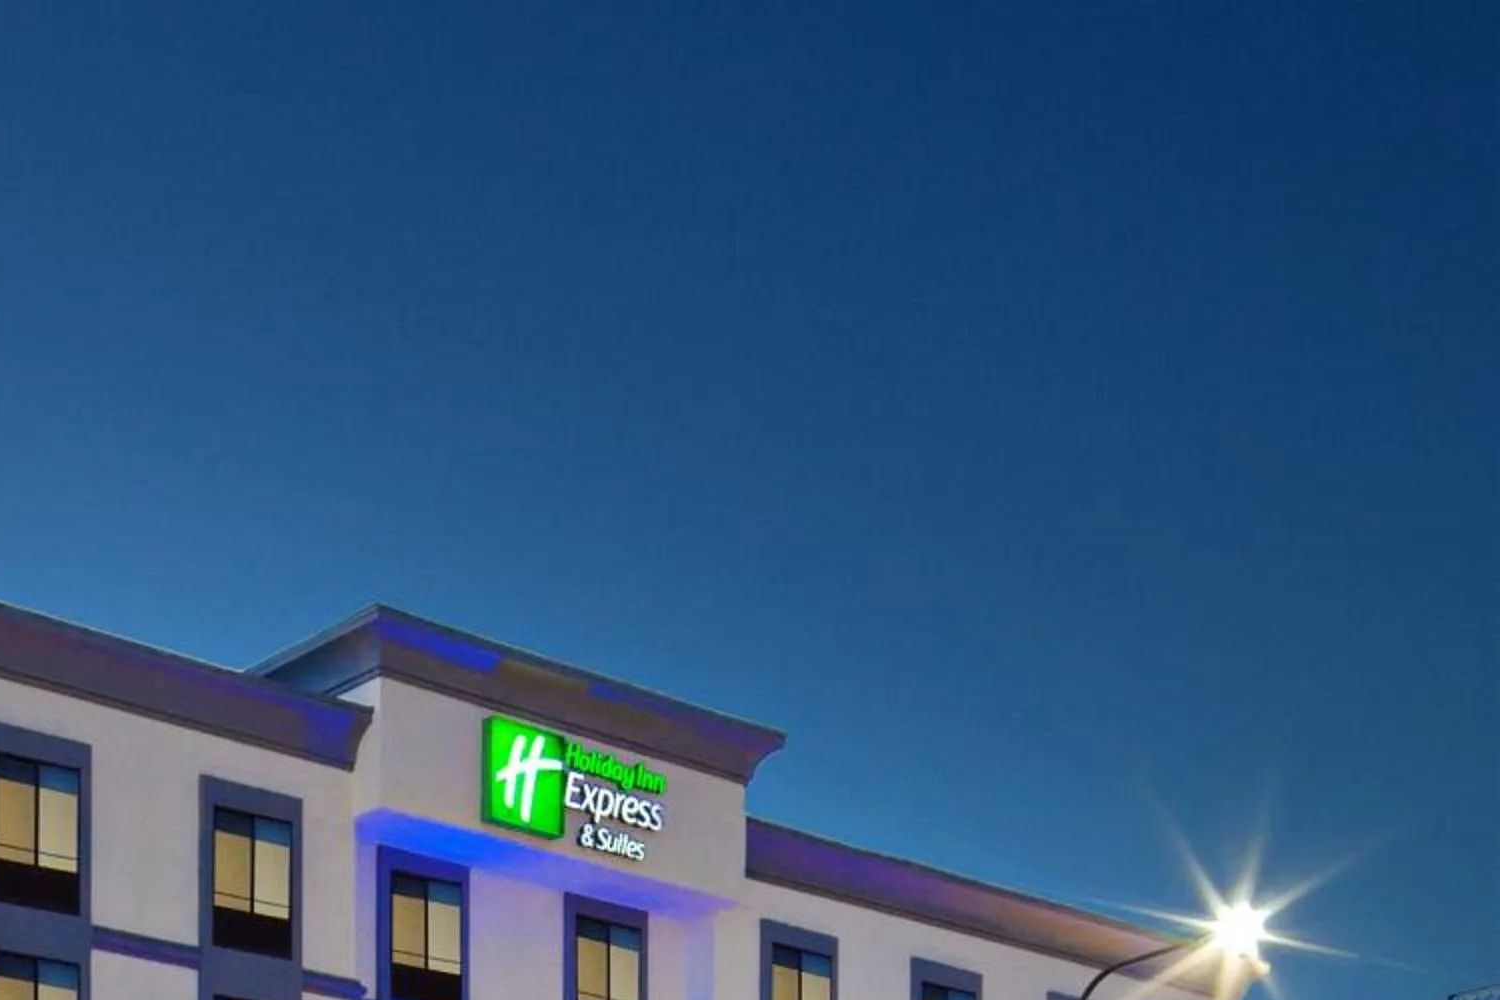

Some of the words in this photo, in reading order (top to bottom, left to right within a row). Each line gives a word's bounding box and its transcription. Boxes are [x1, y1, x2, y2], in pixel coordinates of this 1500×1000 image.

[565, 740, 635, 789] Holiday
[637, 764, 666, 794] Inn
[564, 771, 663, 831] Express
[581, 824, 594, 847] &
[596, 829, 645, 861] Suites
